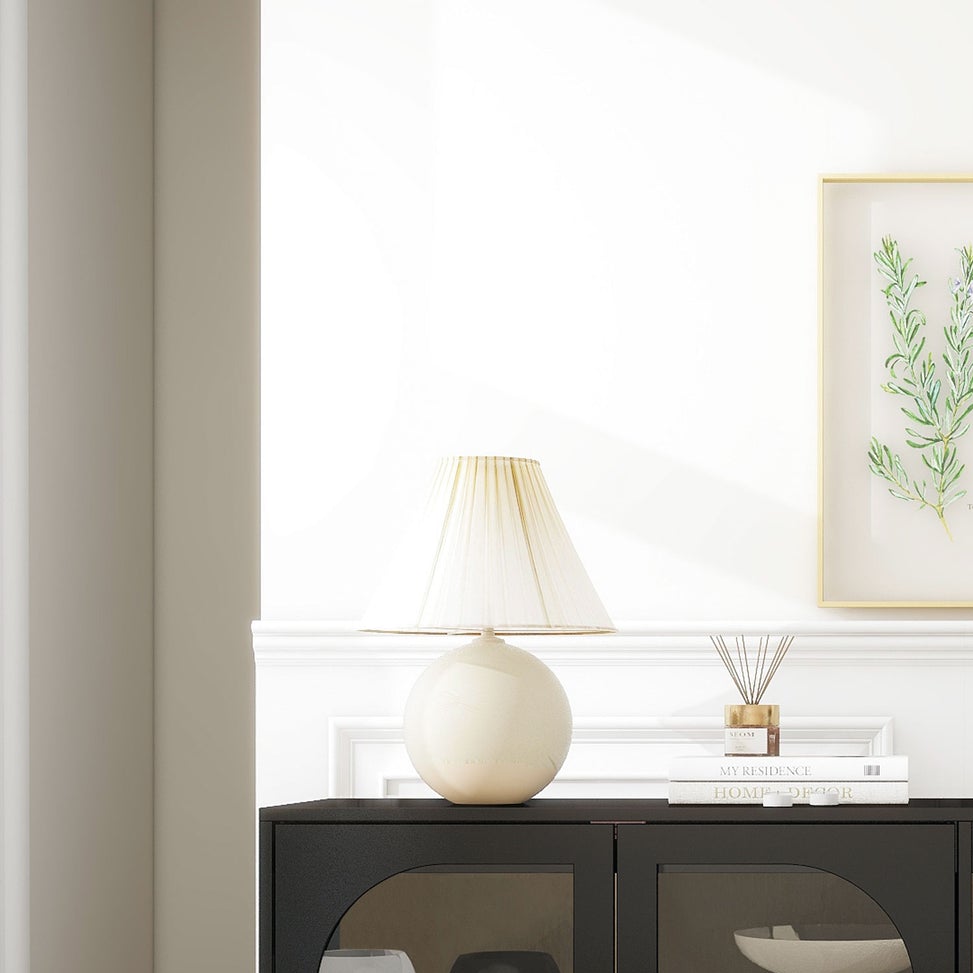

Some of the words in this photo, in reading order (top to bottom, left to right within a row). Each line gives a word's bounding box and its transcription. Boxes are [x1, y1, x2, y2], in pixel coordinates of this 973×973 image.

[720, 766, 739, 776] MY
[742, 766, 812, 776] RESIDENCE
[714, 787, 771, 799] HOME
